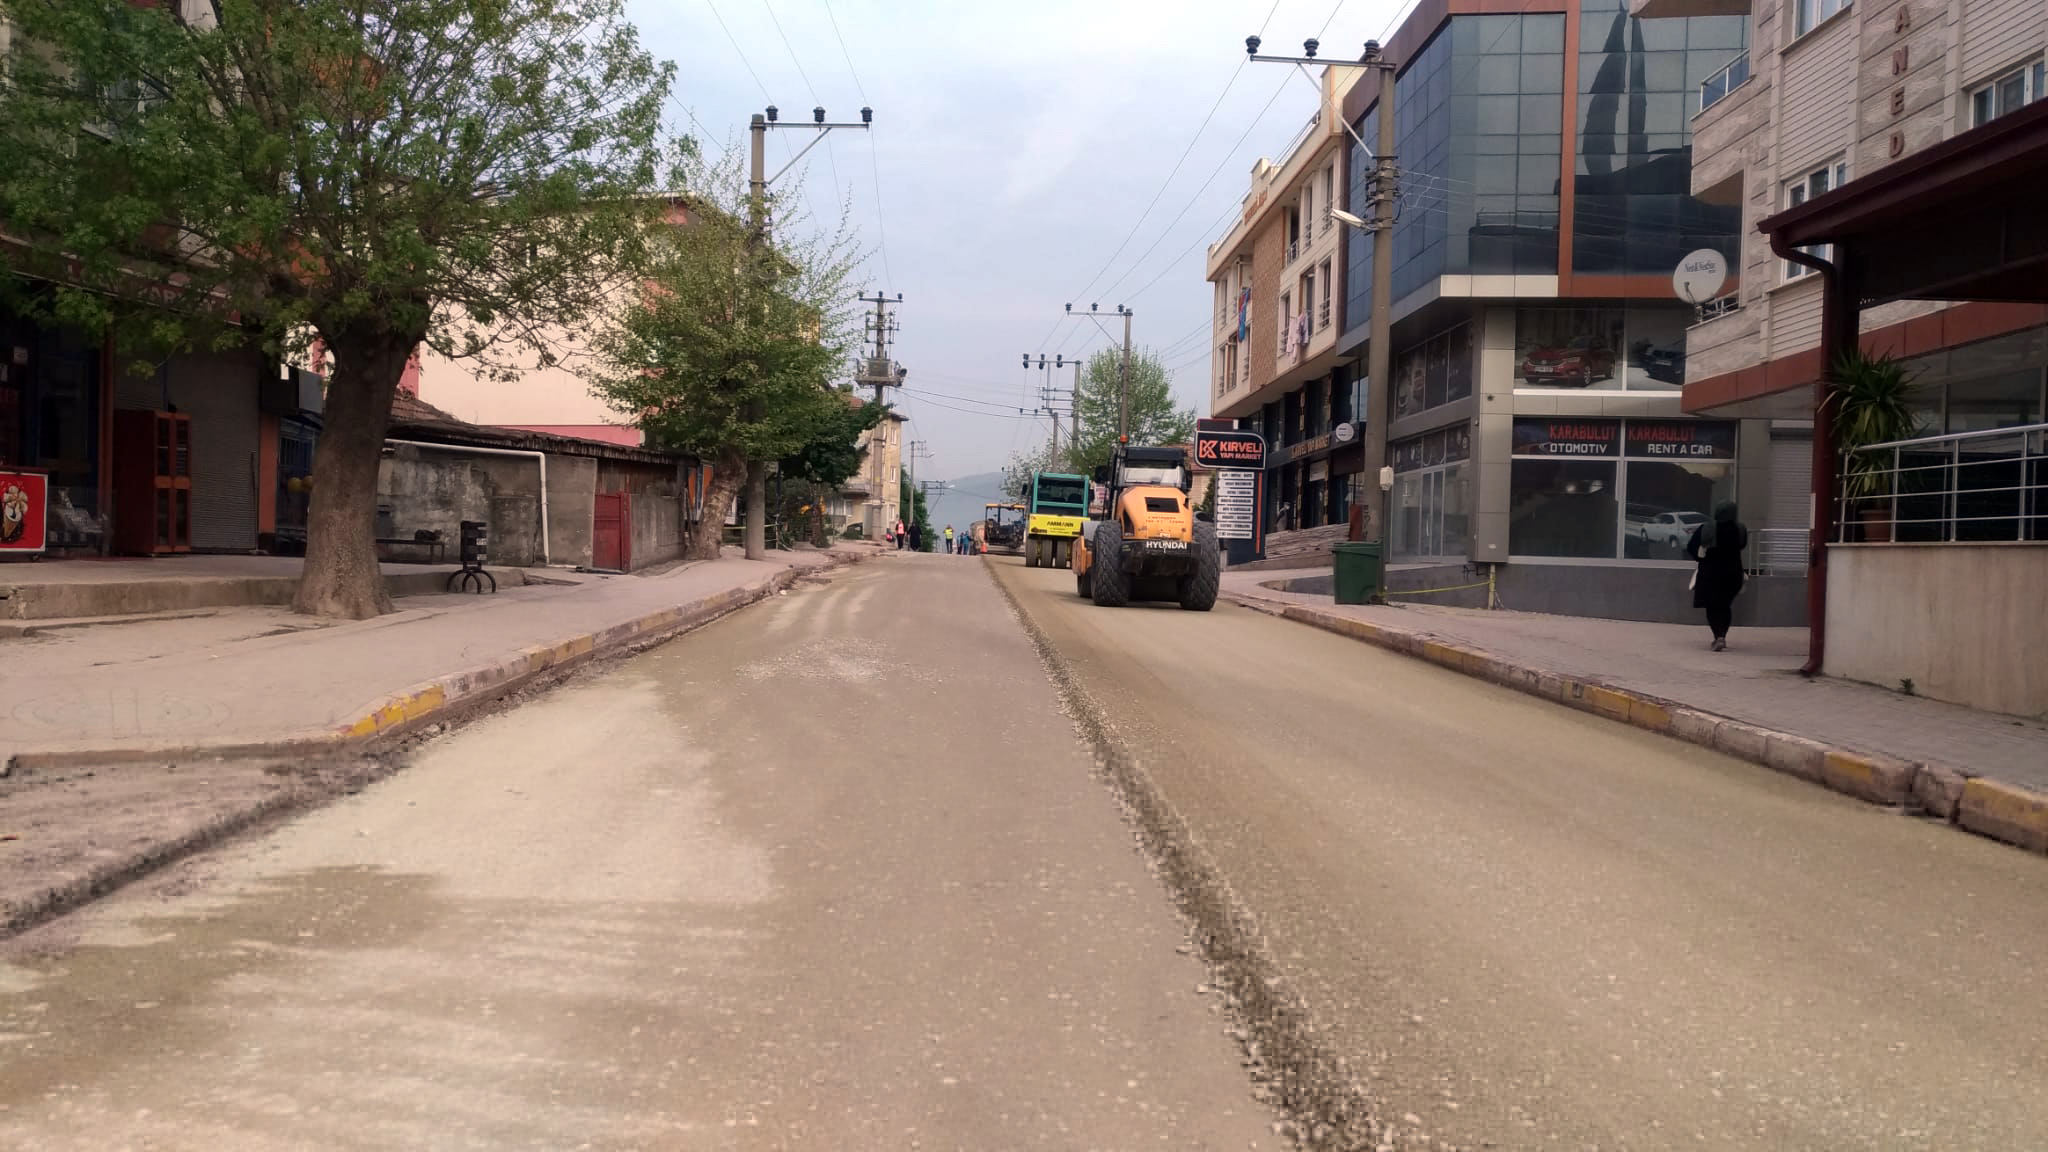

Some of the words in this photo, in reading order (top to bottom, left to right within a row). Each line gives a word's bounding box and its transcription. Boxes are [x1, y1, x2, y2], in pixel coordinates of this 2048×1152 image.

[1549, 424, 1617, 440] KARABULUT
[1628, 425, 1696, 441] KARABULUT
[1550, 443, 1608, 454] OTOMOTIV
[1648, 444, 1677, 454] RENT
[1679, 444, 1688, 454] A
[1690, 444, 1713, 455] CAR
[1146, 541, 1188, 550] HYUNDAI
